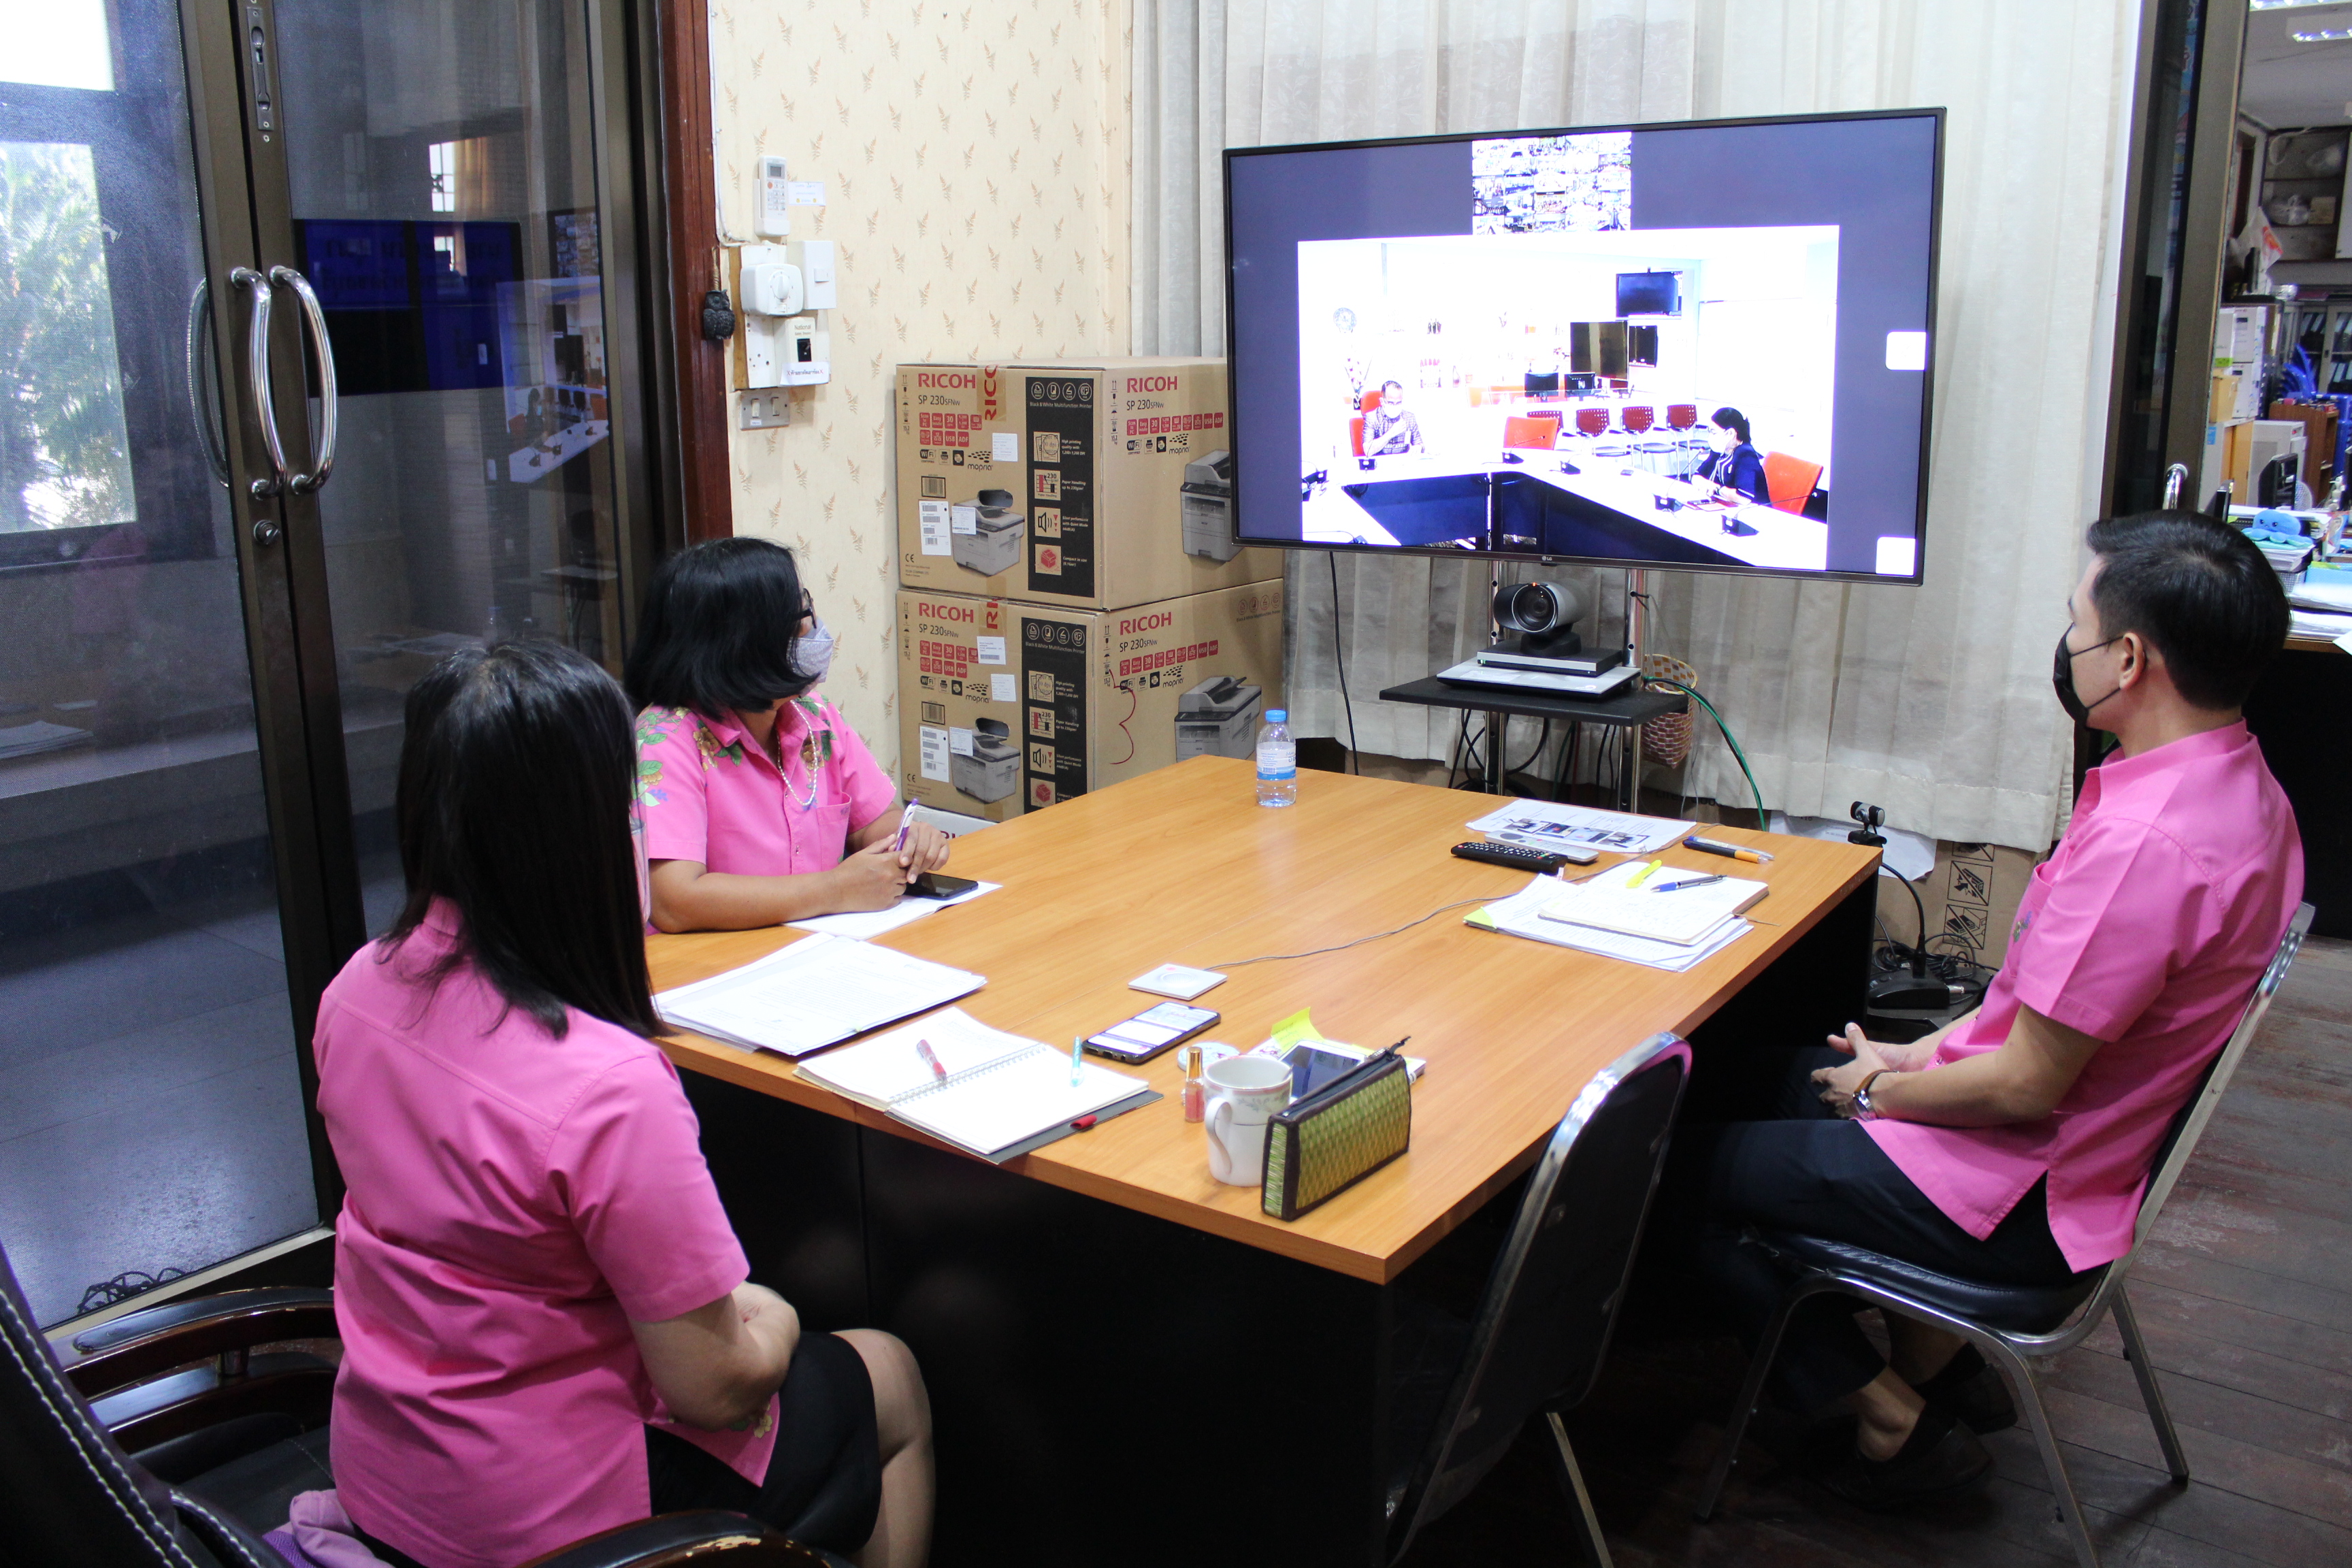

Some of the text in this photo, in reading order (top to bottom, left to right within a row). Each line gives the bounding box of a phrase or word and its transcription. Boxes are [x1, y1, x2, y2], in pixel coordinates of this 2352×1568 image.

[918, 373, 976, 389] RICOH
[1127, 376, 1177, 393] RICOH
[919, 395, 928, 404] SP
[1126, 400, 1135, 410] SP
[1169, 447, 1190, 455] mopria
[967, 463, 992, 472] mopria
[919, 602, 974, 623] RICOH
[919, 623, 928, 633] SP
[1120, 612, 1172, 636] RICOH
[1048, 644, 1073, 653] Multifunction
[1120, 642, 1128, 653] SP
[1162, 678, 1183, 688] mopria
[966, 694, 990, 704] mopria
